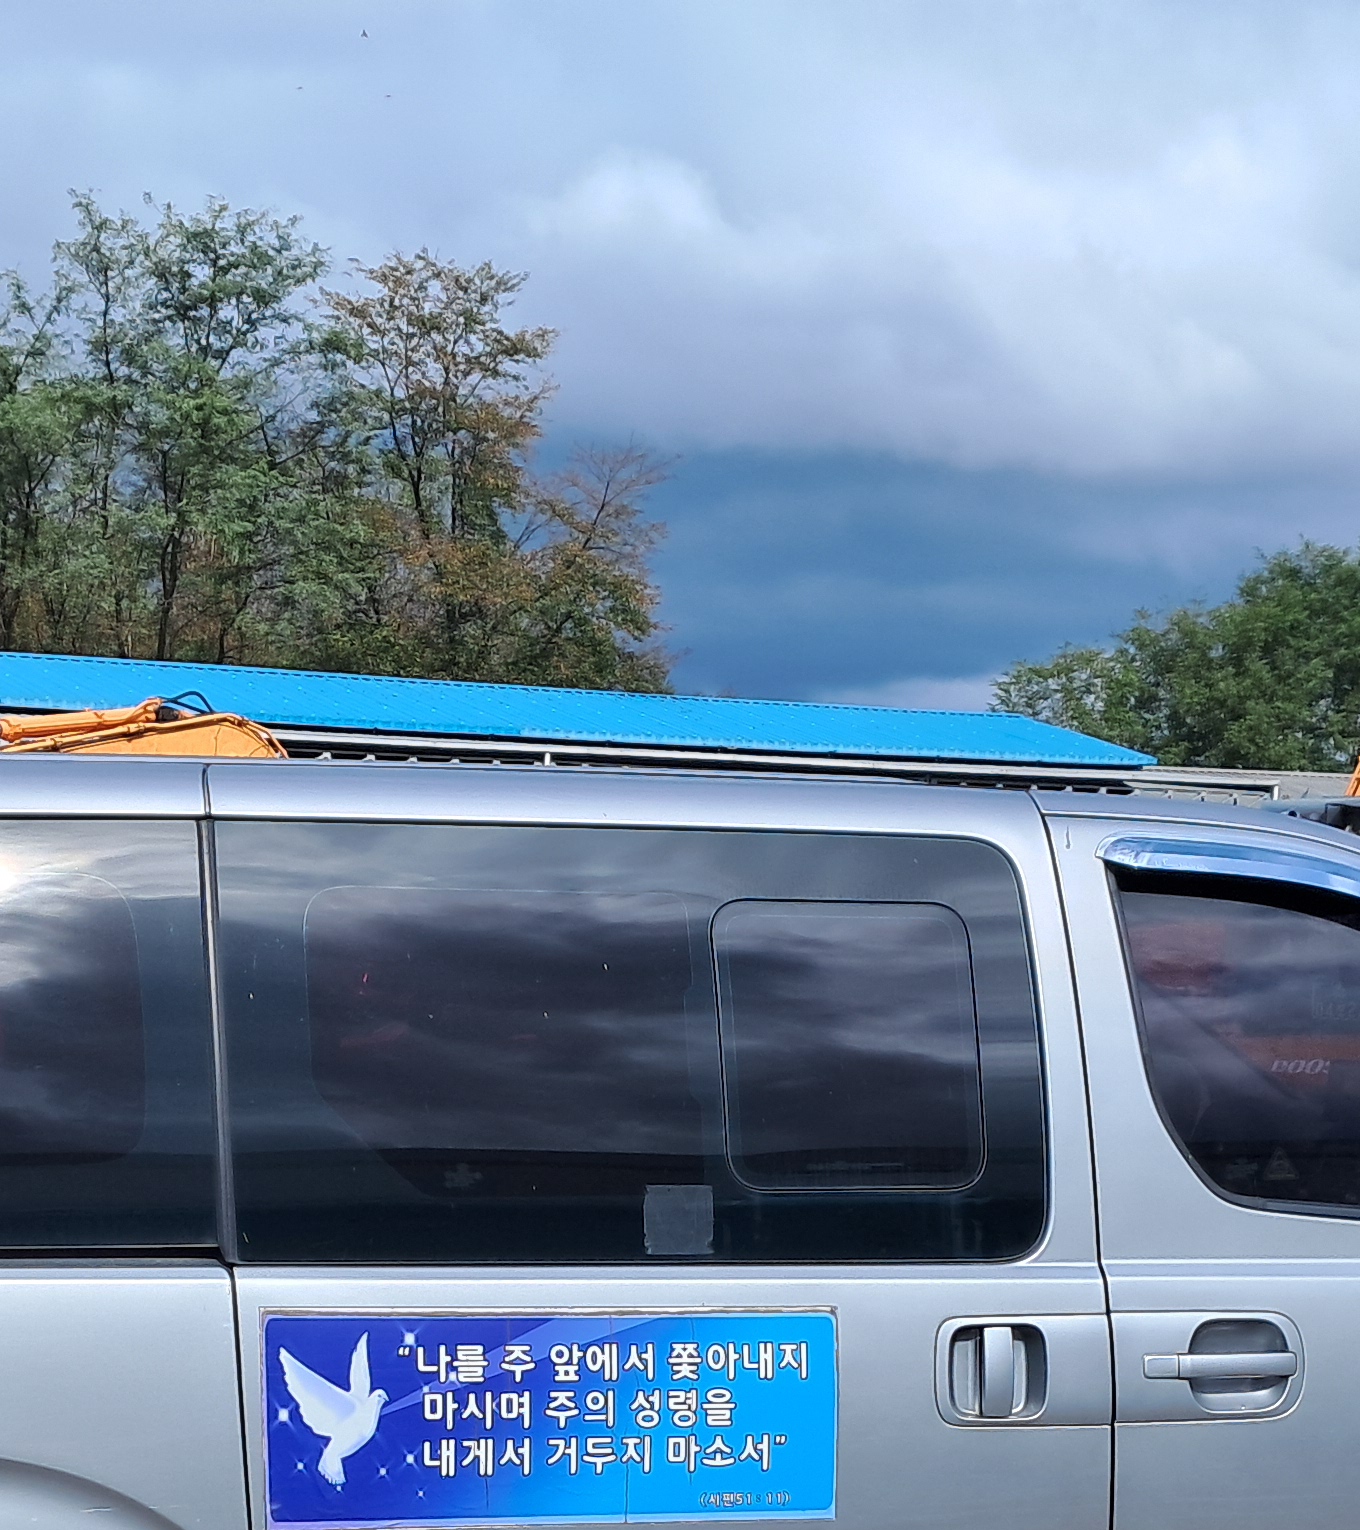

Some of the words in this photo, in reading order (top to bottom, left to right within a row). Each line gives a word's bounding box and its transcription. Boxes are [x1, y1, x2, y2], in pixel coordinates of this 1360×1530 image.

[499, 1344, 537, 1384] 주
[548, 1342, 656, 1383] 앞에서
[666, 1341, 809, 1382] 쫓아내지
[422, 1388, 532, 1431] 마시며
[544, 1389, 616, 1429] 주의
[630, 1387, 738, 1429] 성령을
[422, 1437, 532, 1478] 내게서
[546, 1434, 653, 1475] 거두지
